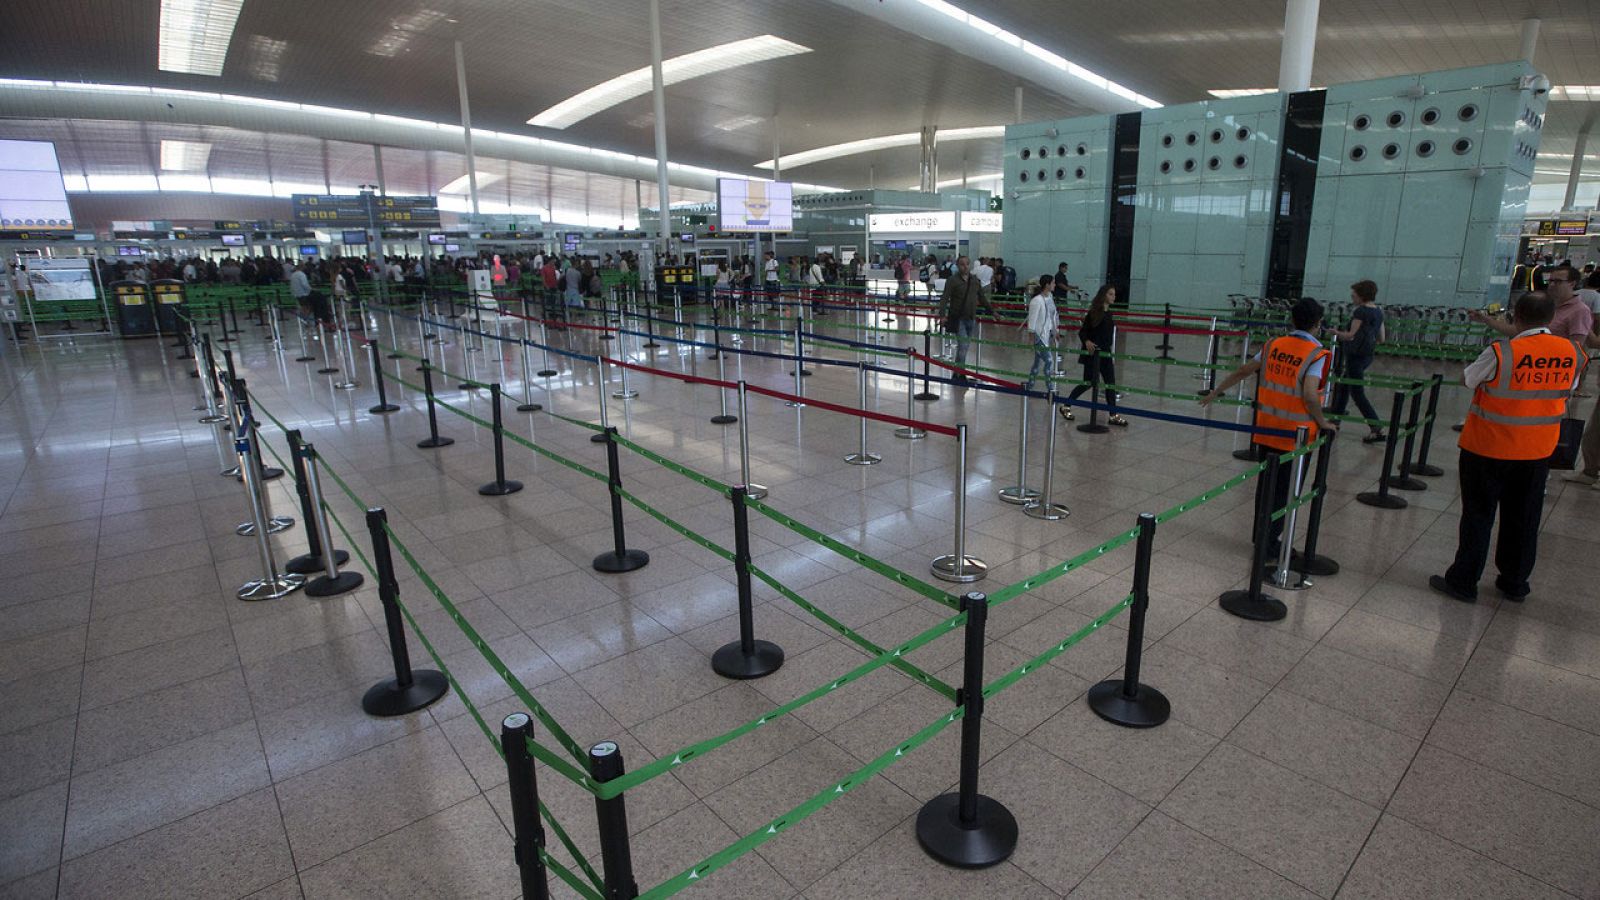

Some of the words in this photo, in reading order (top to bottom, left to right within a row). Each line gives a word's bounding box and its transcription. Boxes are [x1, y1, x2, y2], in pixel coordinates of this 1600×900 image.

[894, 217, 938, 229] exchange
[970, 217, 1000, 227] cambio
[1270, 347, 1302, 366] Aena
[1515, 354, 1573, 369] Aena
[1268, 363, 1297, 377] VISITA
[1514, 372, 1570, 384] VISITA
